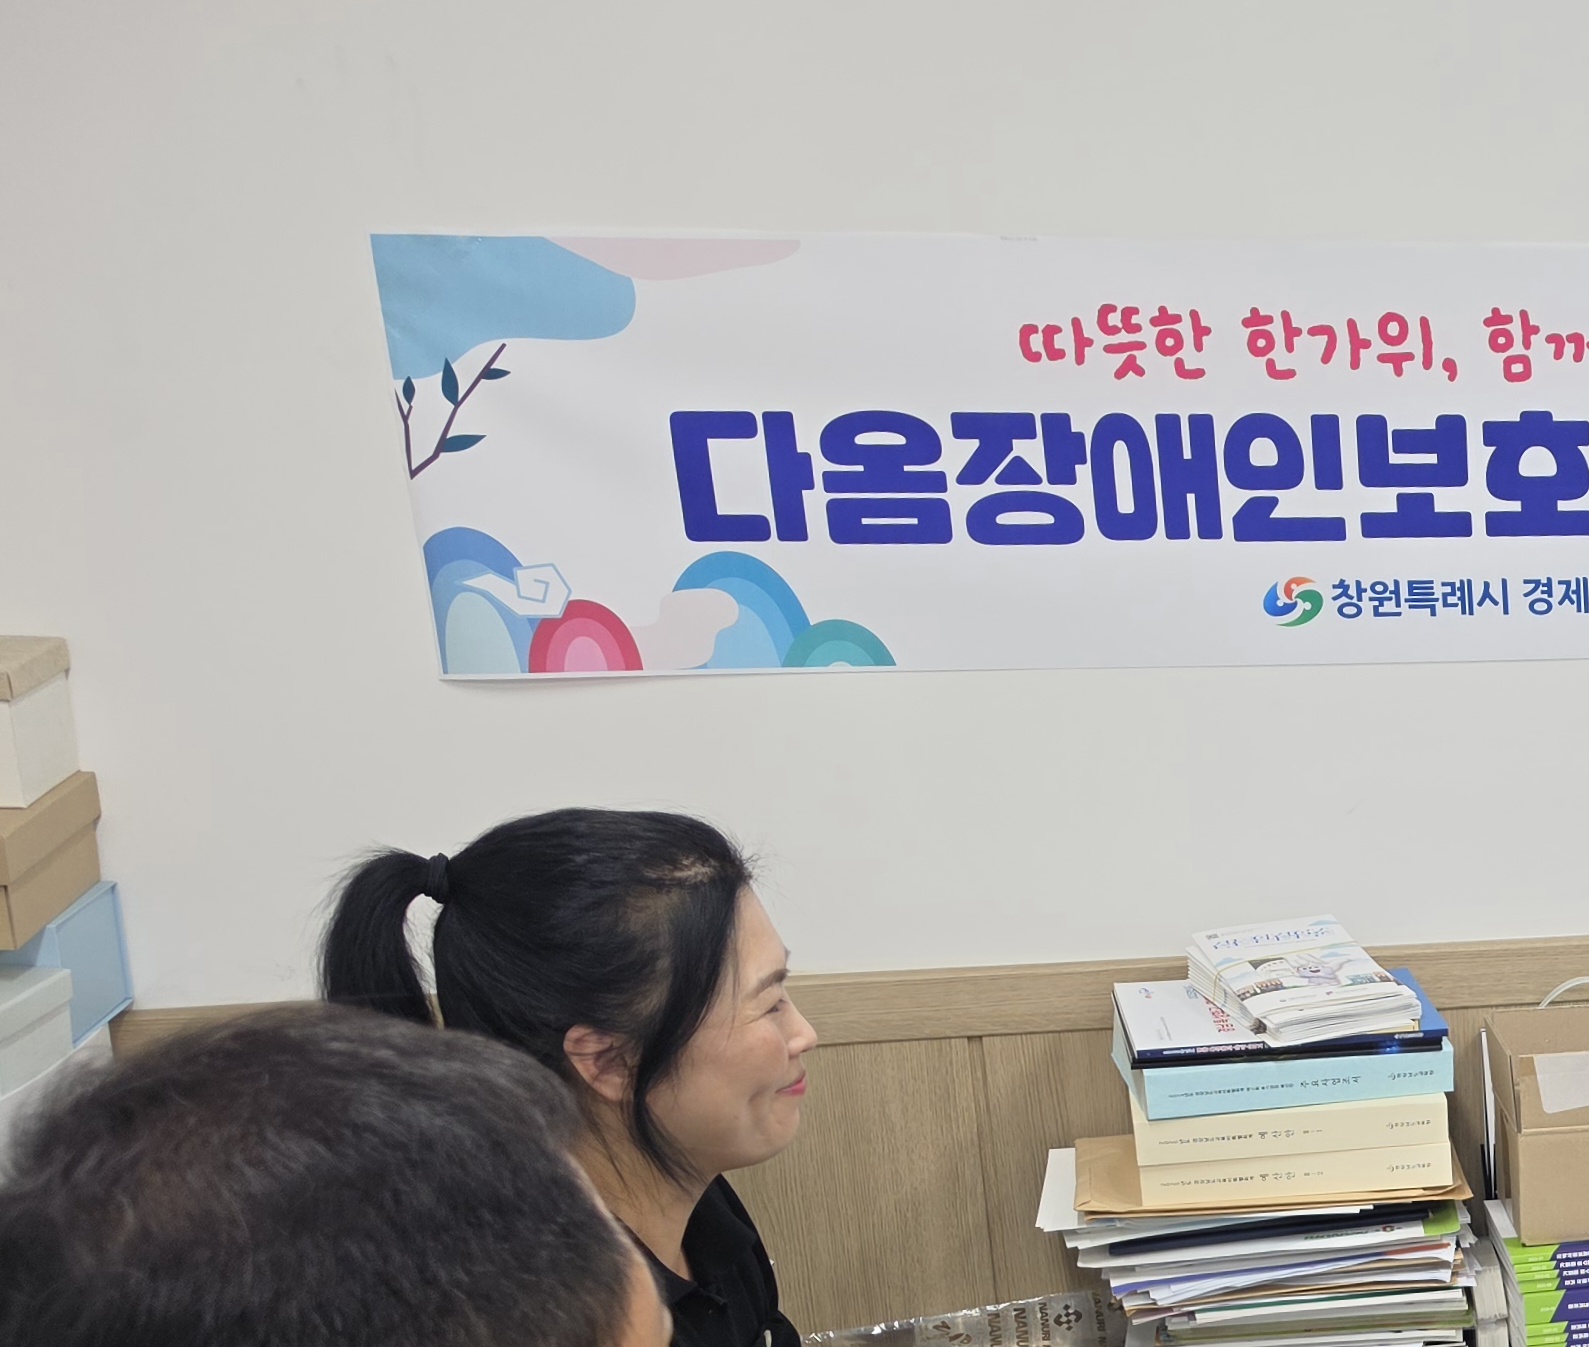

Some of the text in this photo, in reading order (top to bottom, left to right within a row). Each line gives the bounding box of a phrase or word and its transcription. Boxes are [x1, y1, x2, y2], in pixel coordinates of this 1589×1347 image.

[1019, 303, 1212, 381] 따뜻한
[1241, 307, 1458, 382] 한가위,
[1331, 578, 1510, 620] 창원특례시
[1300, 1075, 1361, 1088] 주요사업조서
[1258, 1129, 1296, 1140] 예산안
[1259, 1171, 1296, 1181] 예산안
